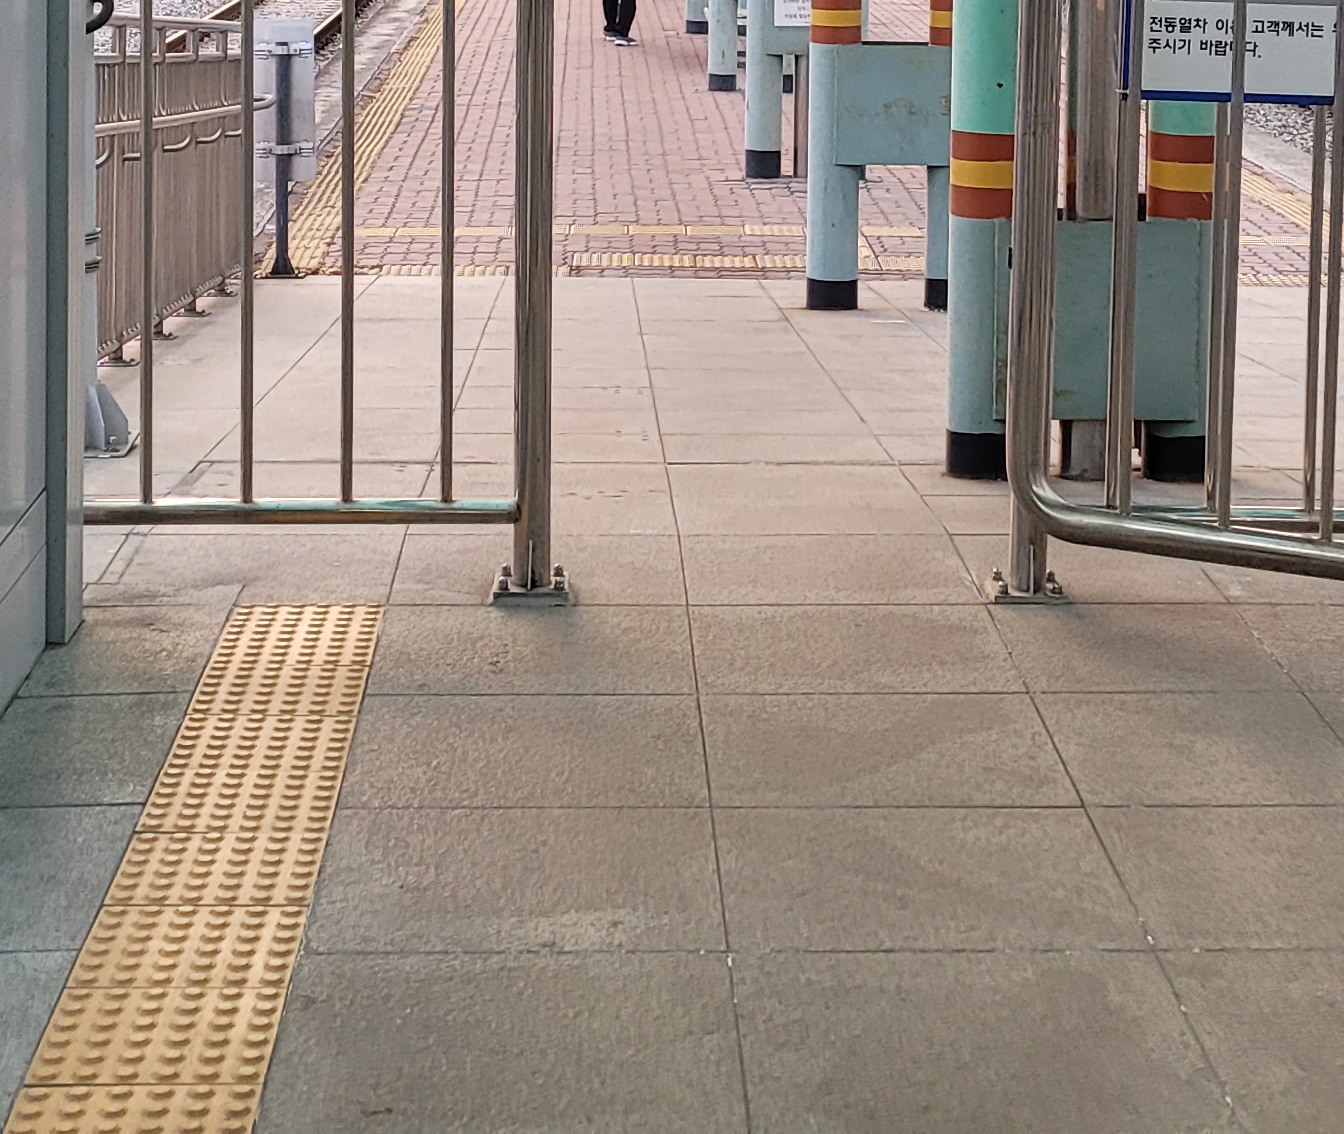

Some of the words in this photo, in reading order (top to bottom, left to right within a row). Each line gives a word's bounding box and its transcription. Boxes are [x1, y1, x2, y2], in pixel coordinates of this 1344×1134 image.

[1149, 16, 1208, 34] 전동열차
[1251, 19, 1324, 38] 고객께서는
[1147, 38, 1192, 55] 주시기
